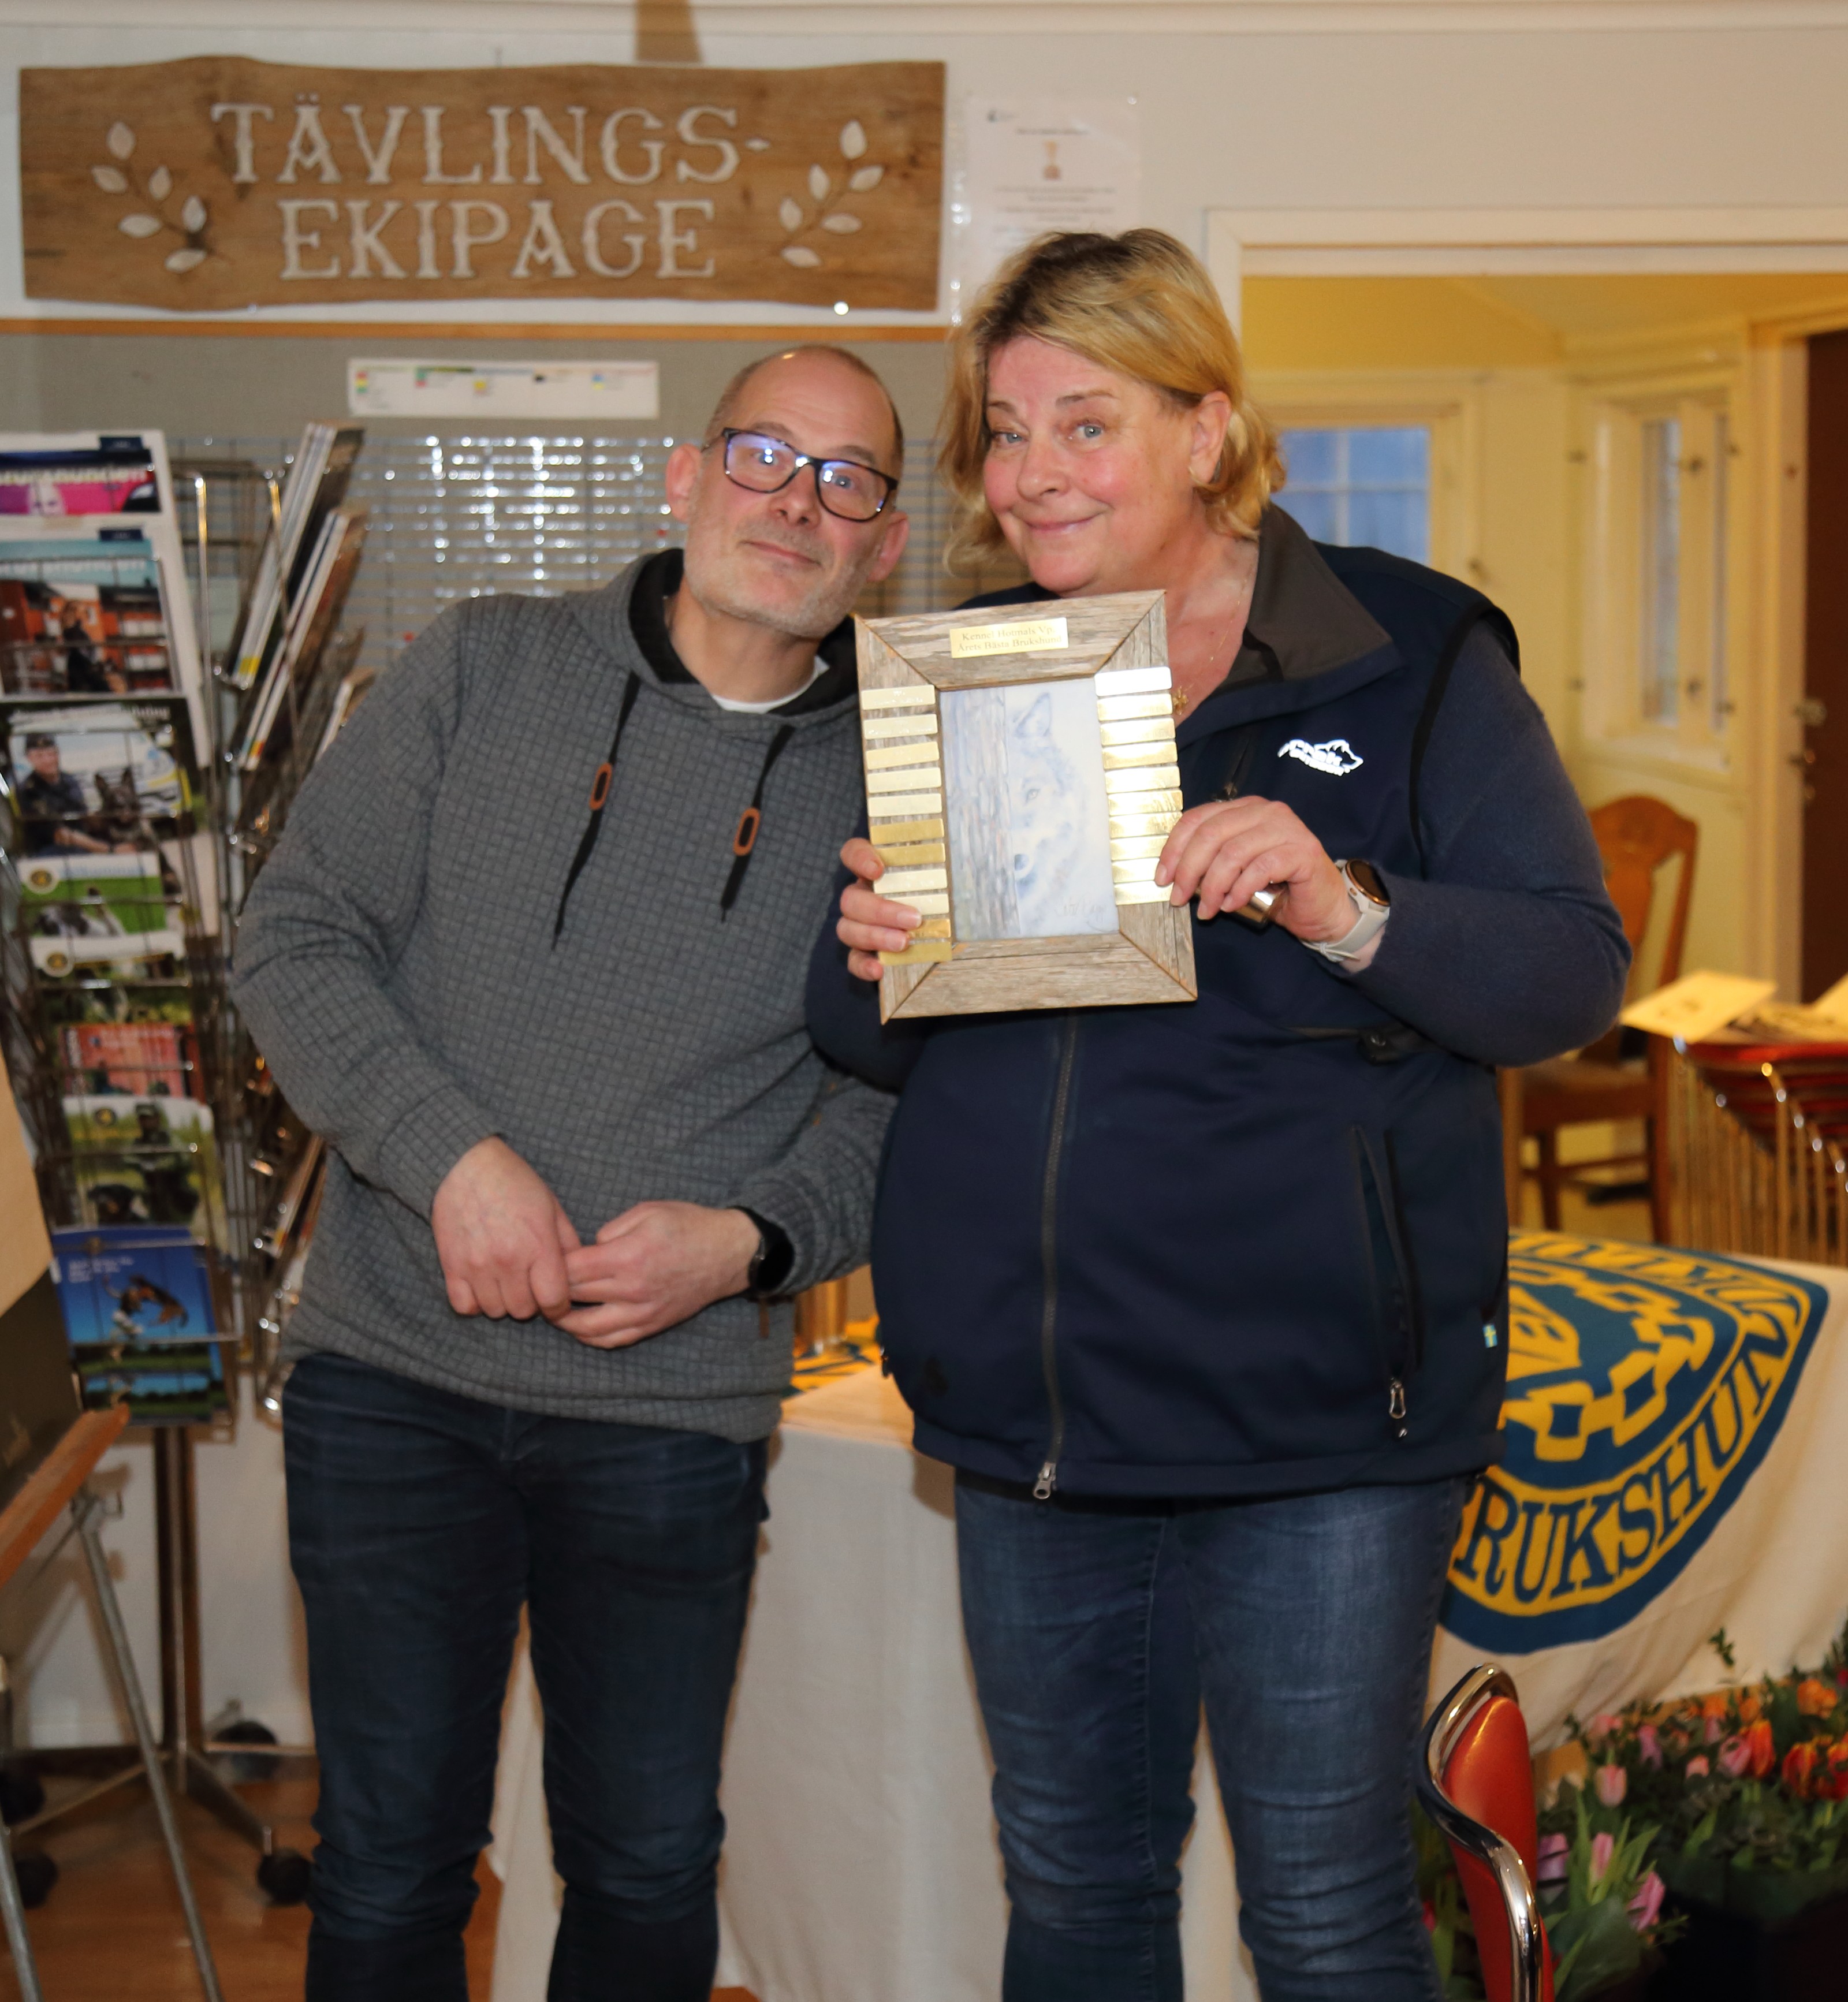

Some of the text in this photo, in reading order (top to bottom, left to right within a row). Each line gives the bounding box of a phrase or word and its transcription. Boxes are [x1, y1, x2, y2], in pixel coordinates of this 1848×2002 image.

[211, 94, 770, 185] TÄVLINGS-
[280, 199, 715, 280] EKIPAGE
[962, 631, 994, 641] Kennel
[985, 641, 1009, 649] Bästa
[1013, 636, 1062, 647] Brukshund
